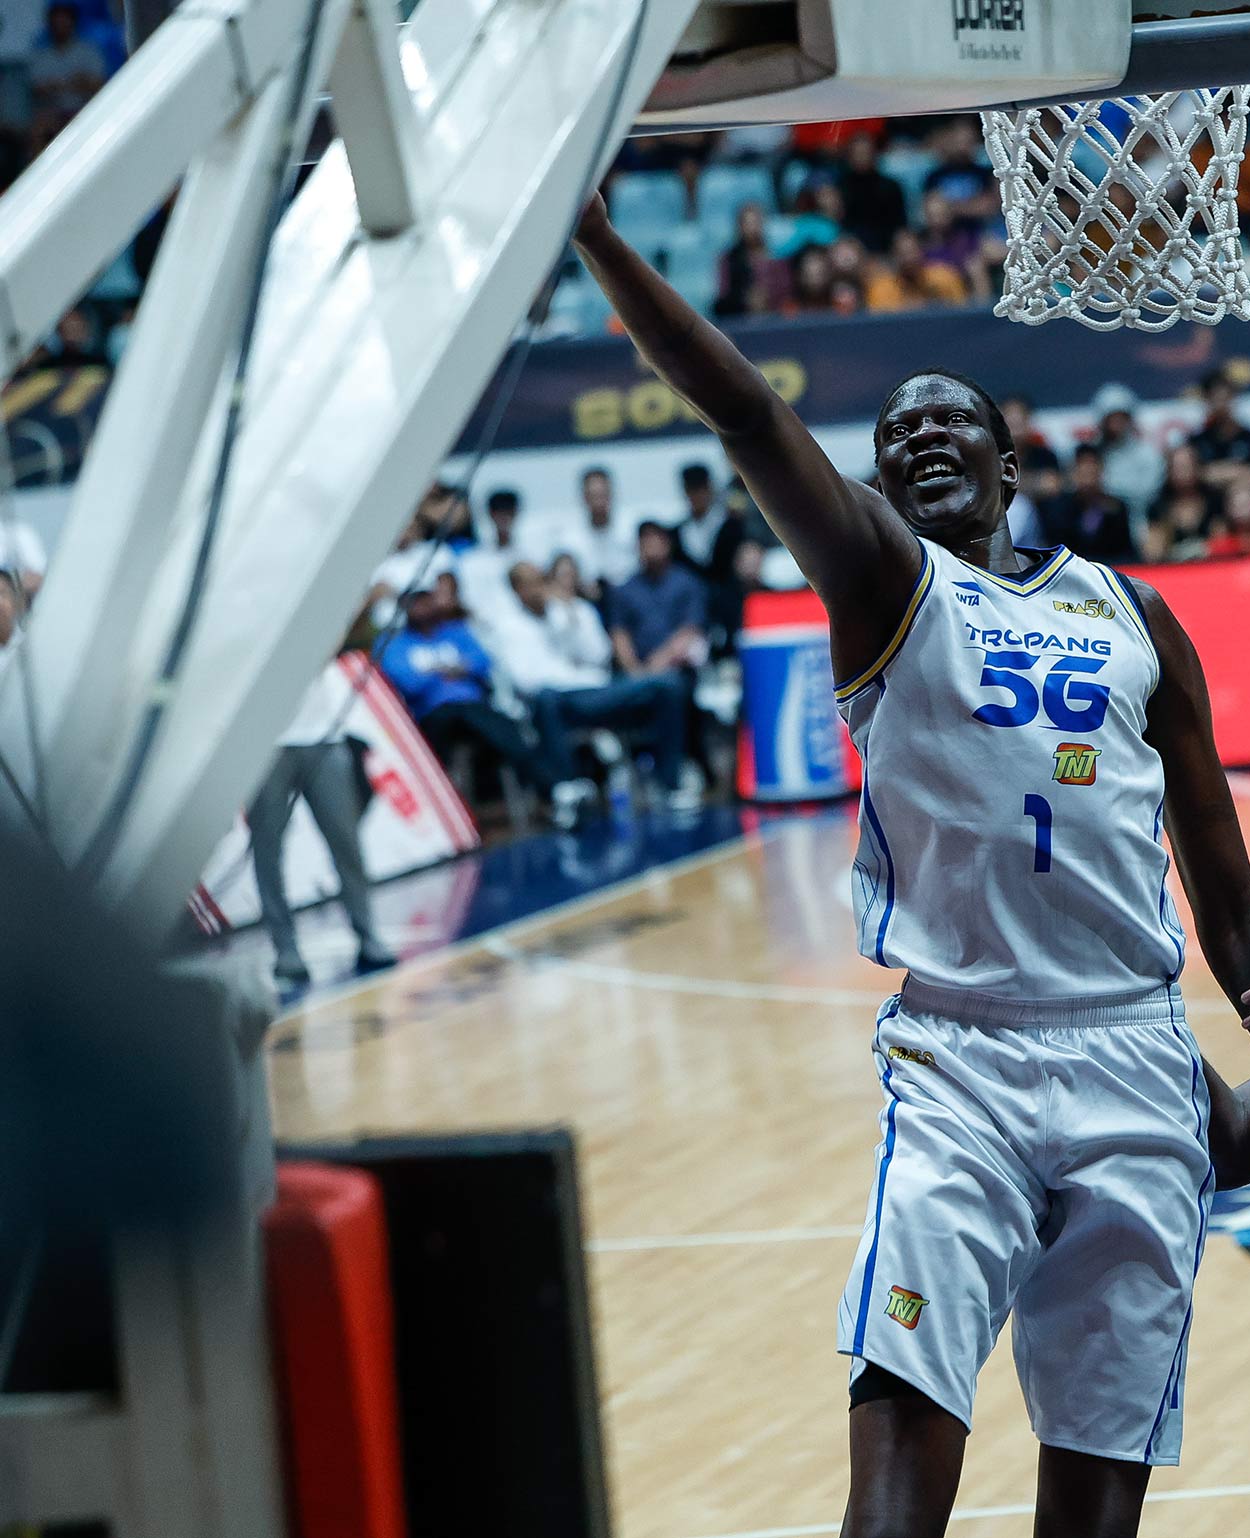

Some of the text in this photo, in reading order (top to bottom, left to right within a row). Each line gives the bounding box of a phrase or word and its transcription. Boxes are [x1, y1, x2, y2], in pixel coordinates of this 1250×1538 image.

[965, 622, 1112, 657] TROPANG
[970, 649, 1111, 733] 5G
[1052, 749, 1102, 780] TNT
[1024, 793, 1052, 872] 1
[884, 1290, 930, 1323] TNT
